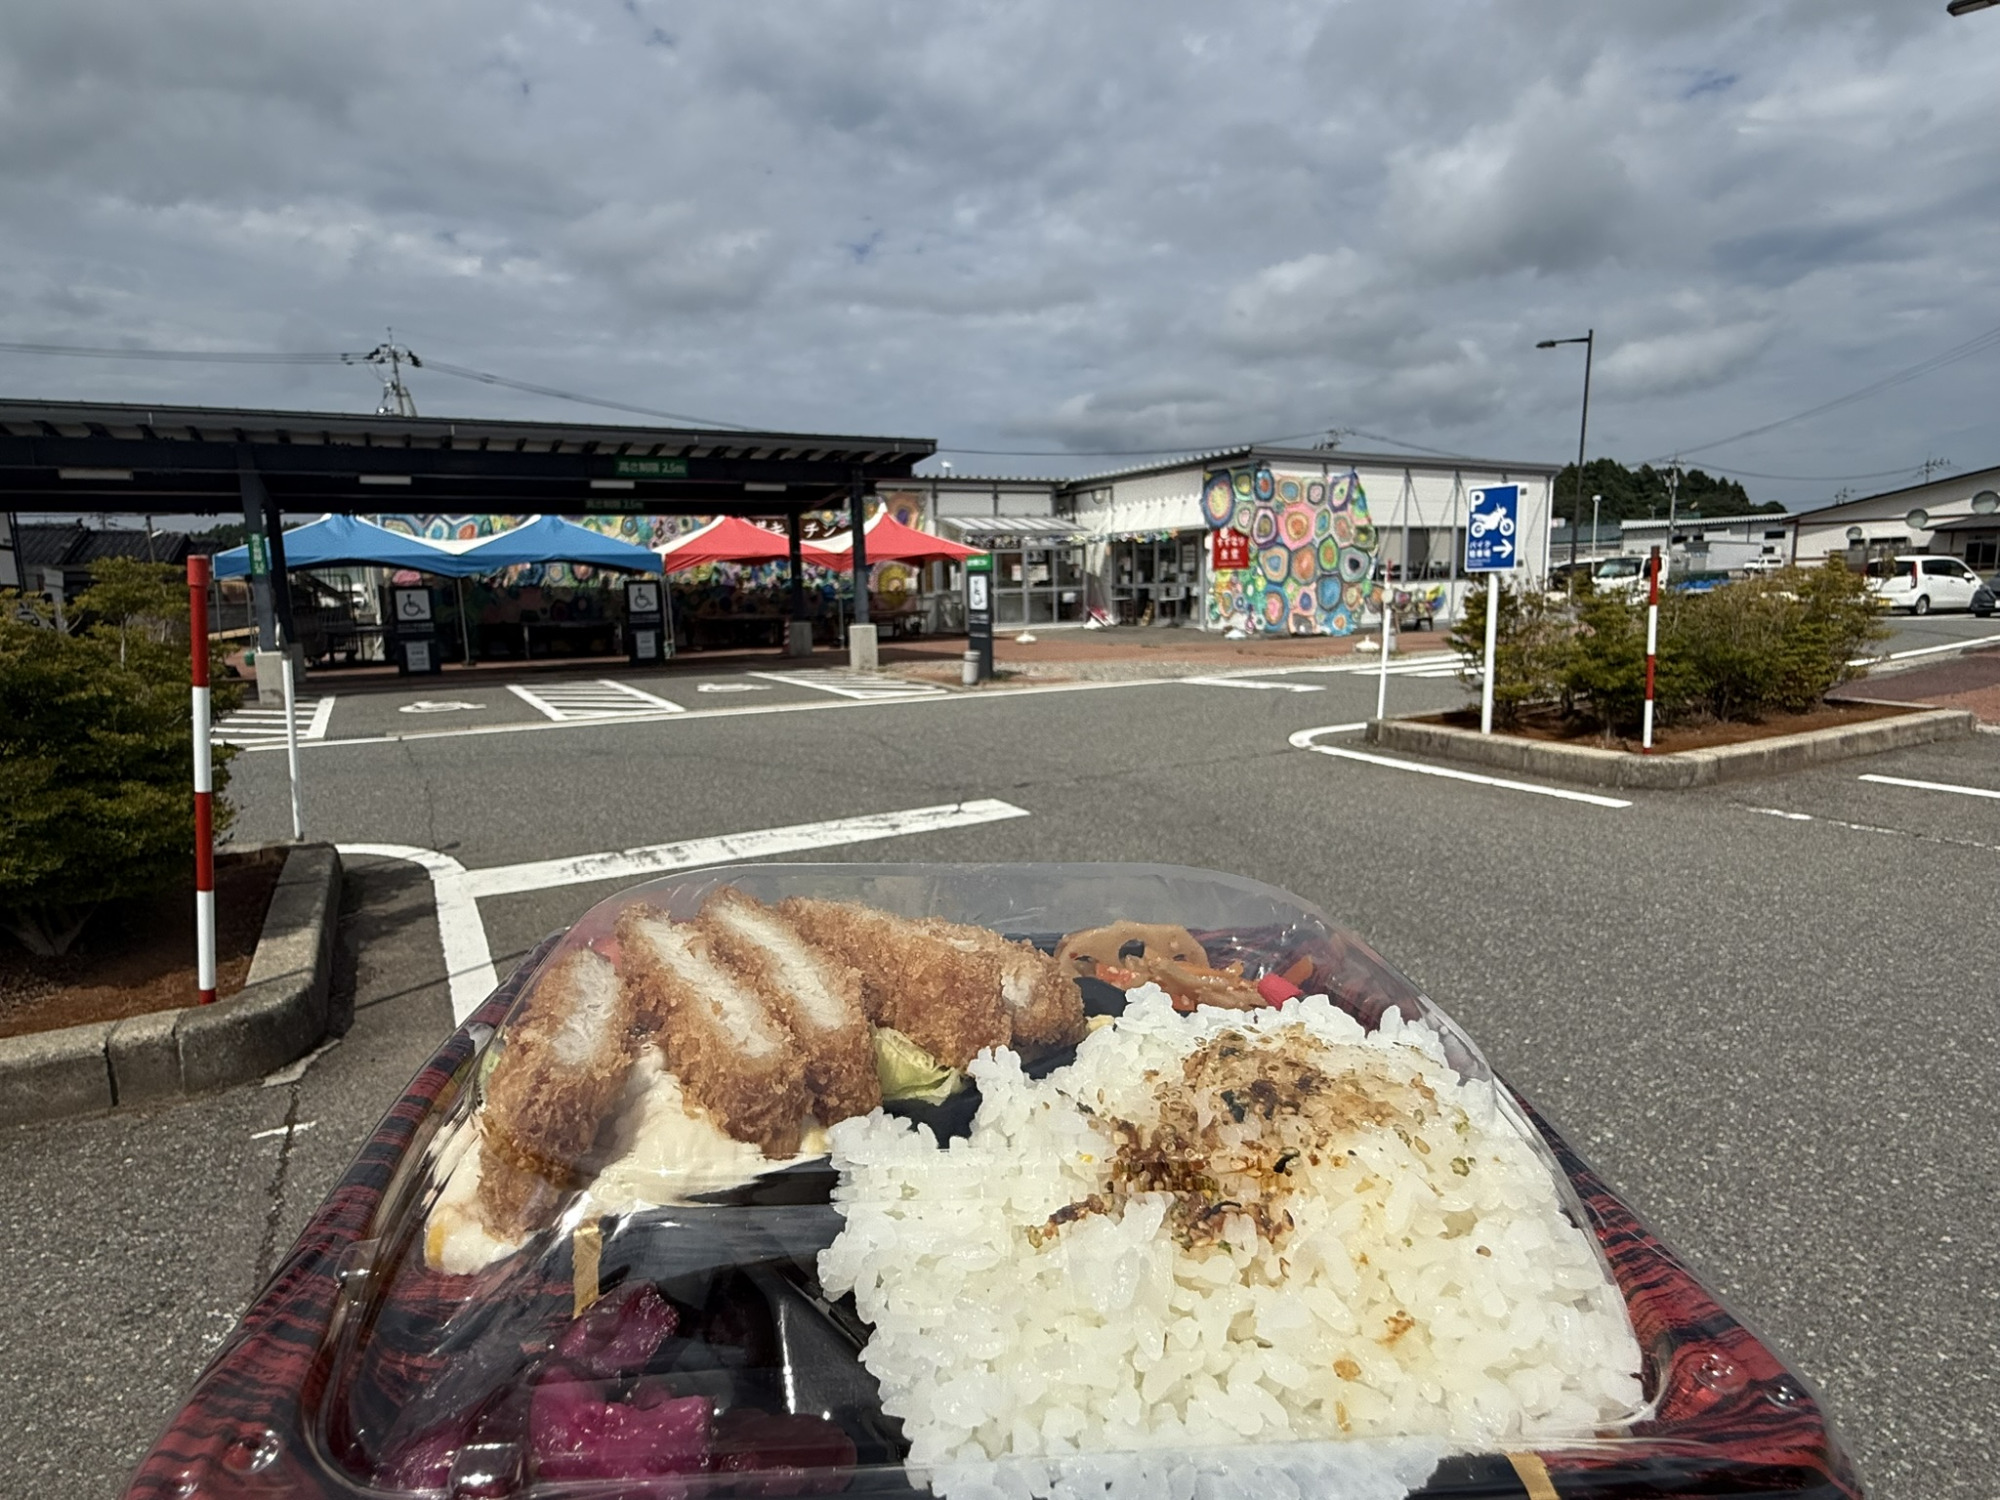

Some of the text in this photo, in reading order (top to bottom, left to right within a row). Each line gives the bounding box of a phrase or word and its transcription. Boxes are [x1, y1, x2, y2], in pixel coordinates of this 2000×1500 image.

[662, 463, 686, 474] 2.5m
[1470, 491, 1485, 512] P
[1469, 540, 1491, 549] バイク
